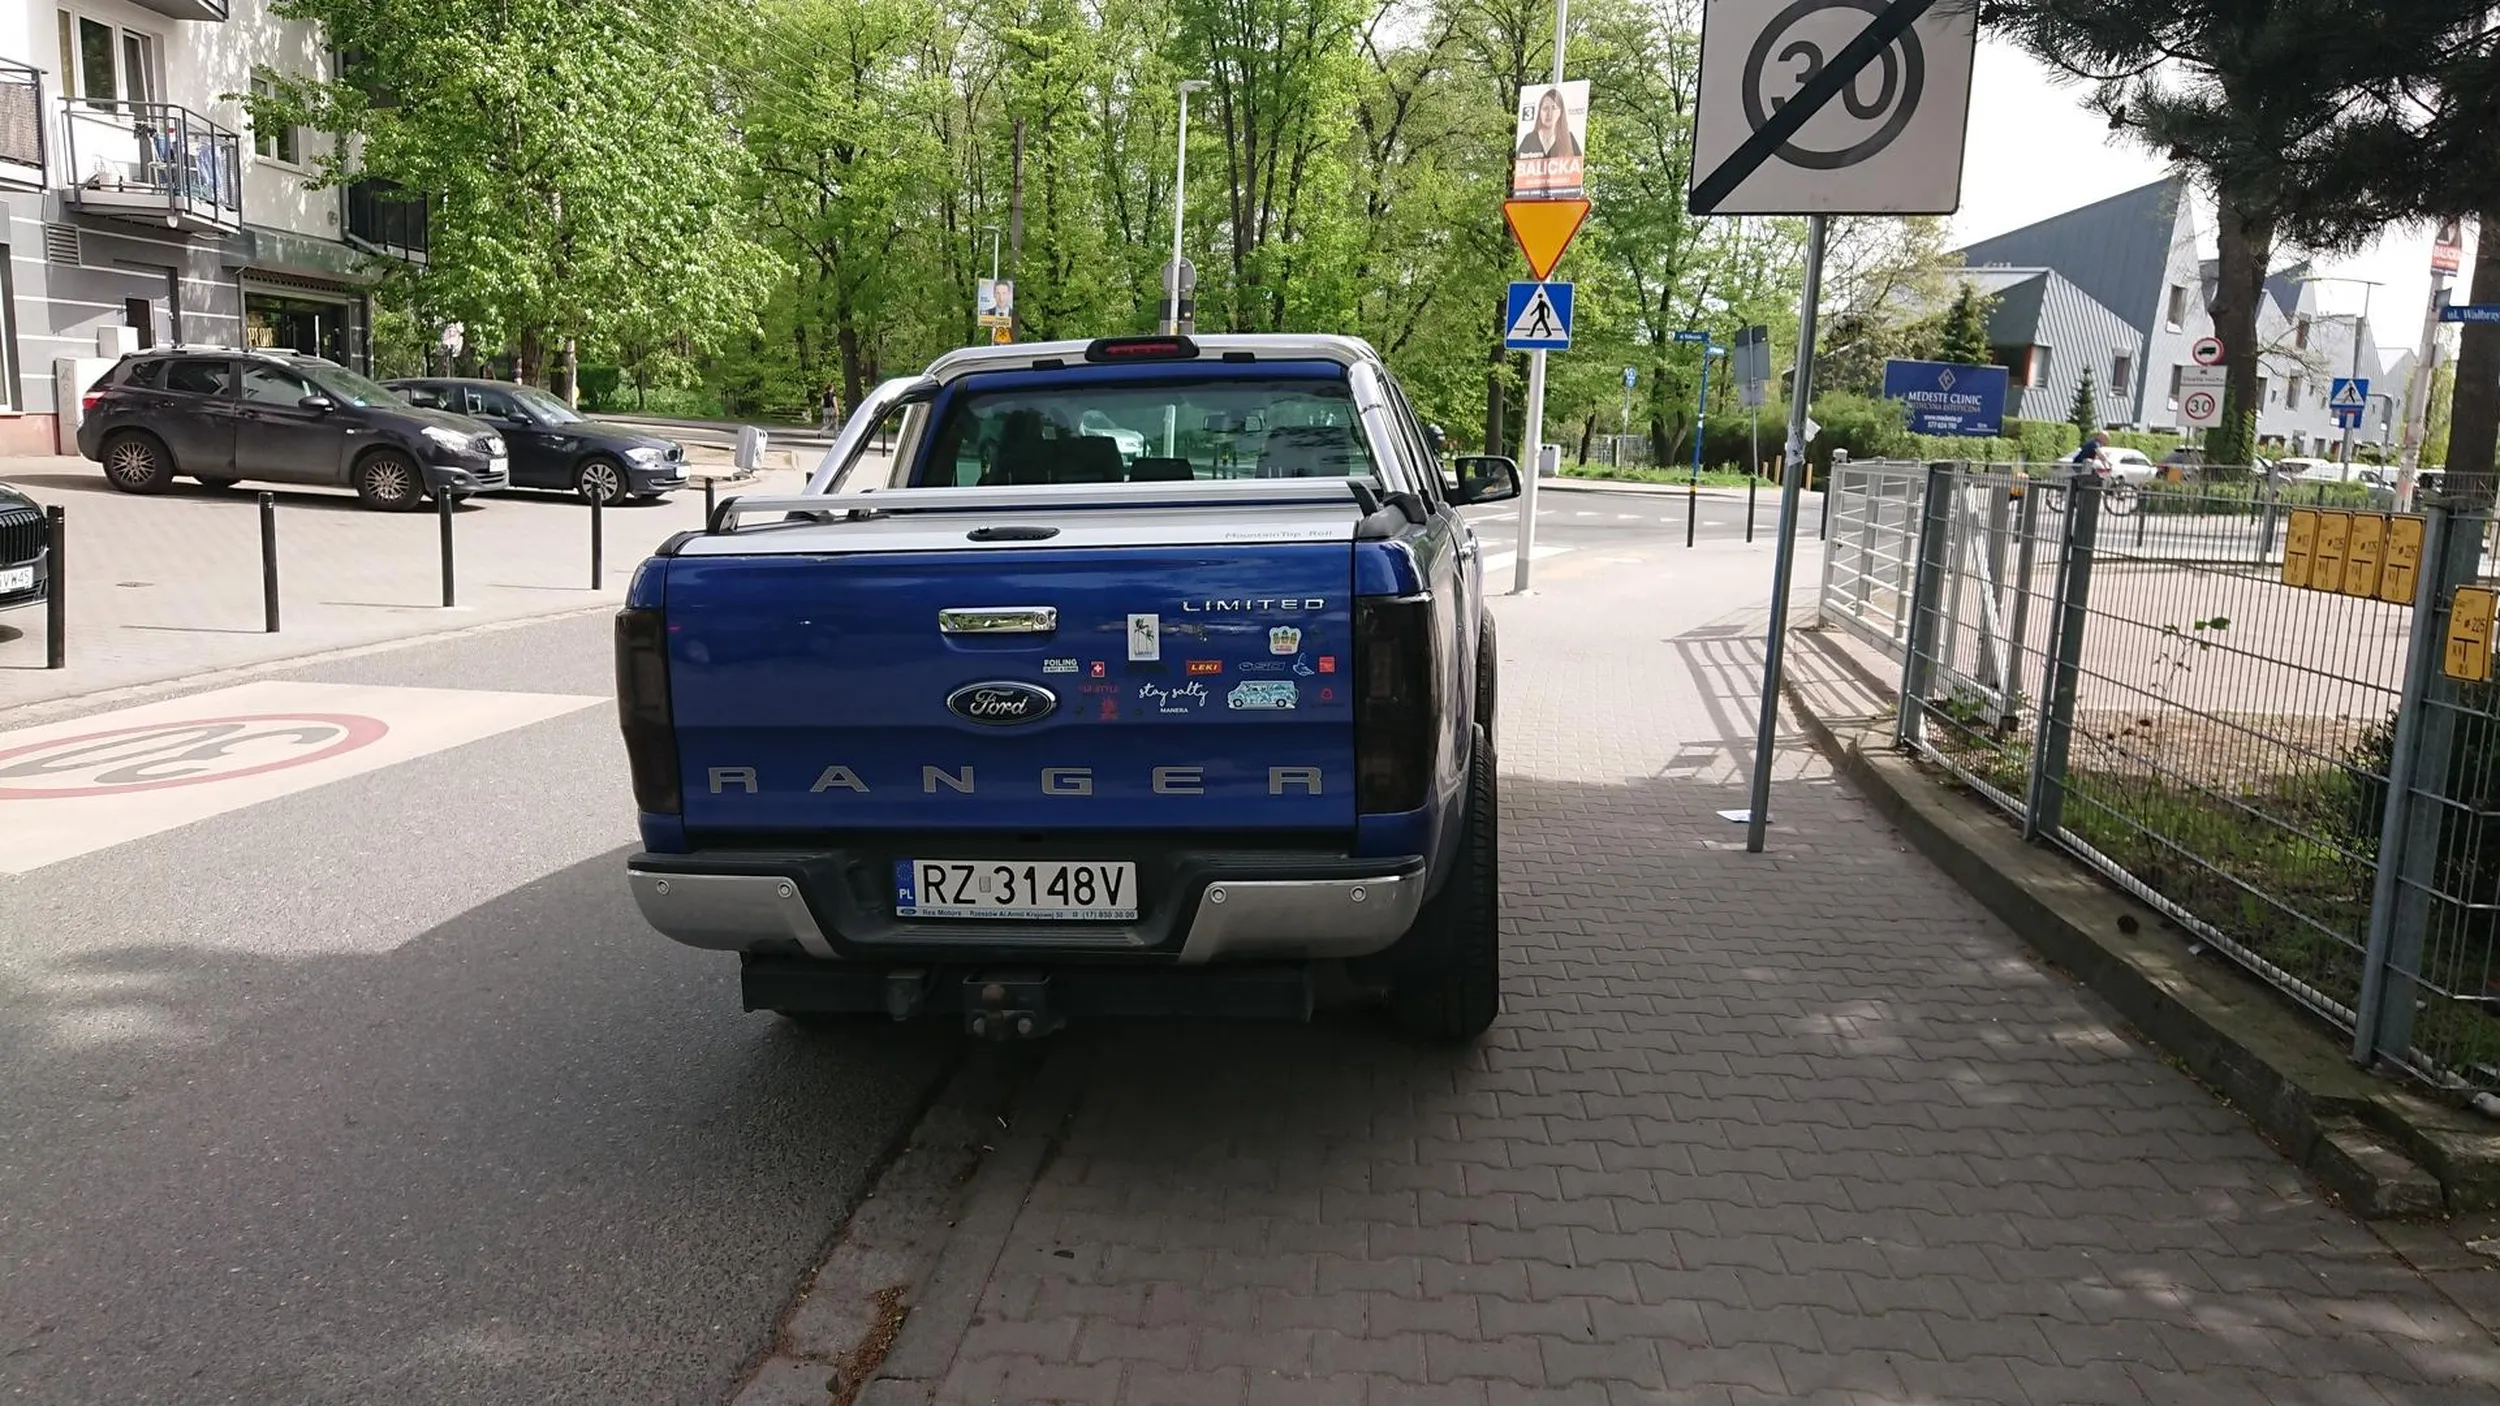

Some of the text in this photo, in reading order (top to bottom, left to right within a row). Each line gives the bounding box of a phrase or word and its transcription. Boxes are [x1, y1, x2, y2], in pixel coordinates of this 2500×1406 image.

[1771, 40, 1899, 120] 30
[1517, 158, 1580, 175] BALICKA
[2447, 310, 2459, 320] ul.
[1908, 391, 1982, 405] MEDESTE CLINIC
[2190, 400, 2211, 413] 30
[1183, 599, 1325, 612] LIMITED
[1044, 658, 1078, 667] FOILING
[1190, 663, 1218, 671] LEKI
[1139, 681, 1209, 707] stay salty
[969, 689, 1029, 715] Ford
[707, 765, 1324, 796] RANGER
[922, 864, 1125, 906] RZ 3148V
[899, 889, 914, 900] PL
